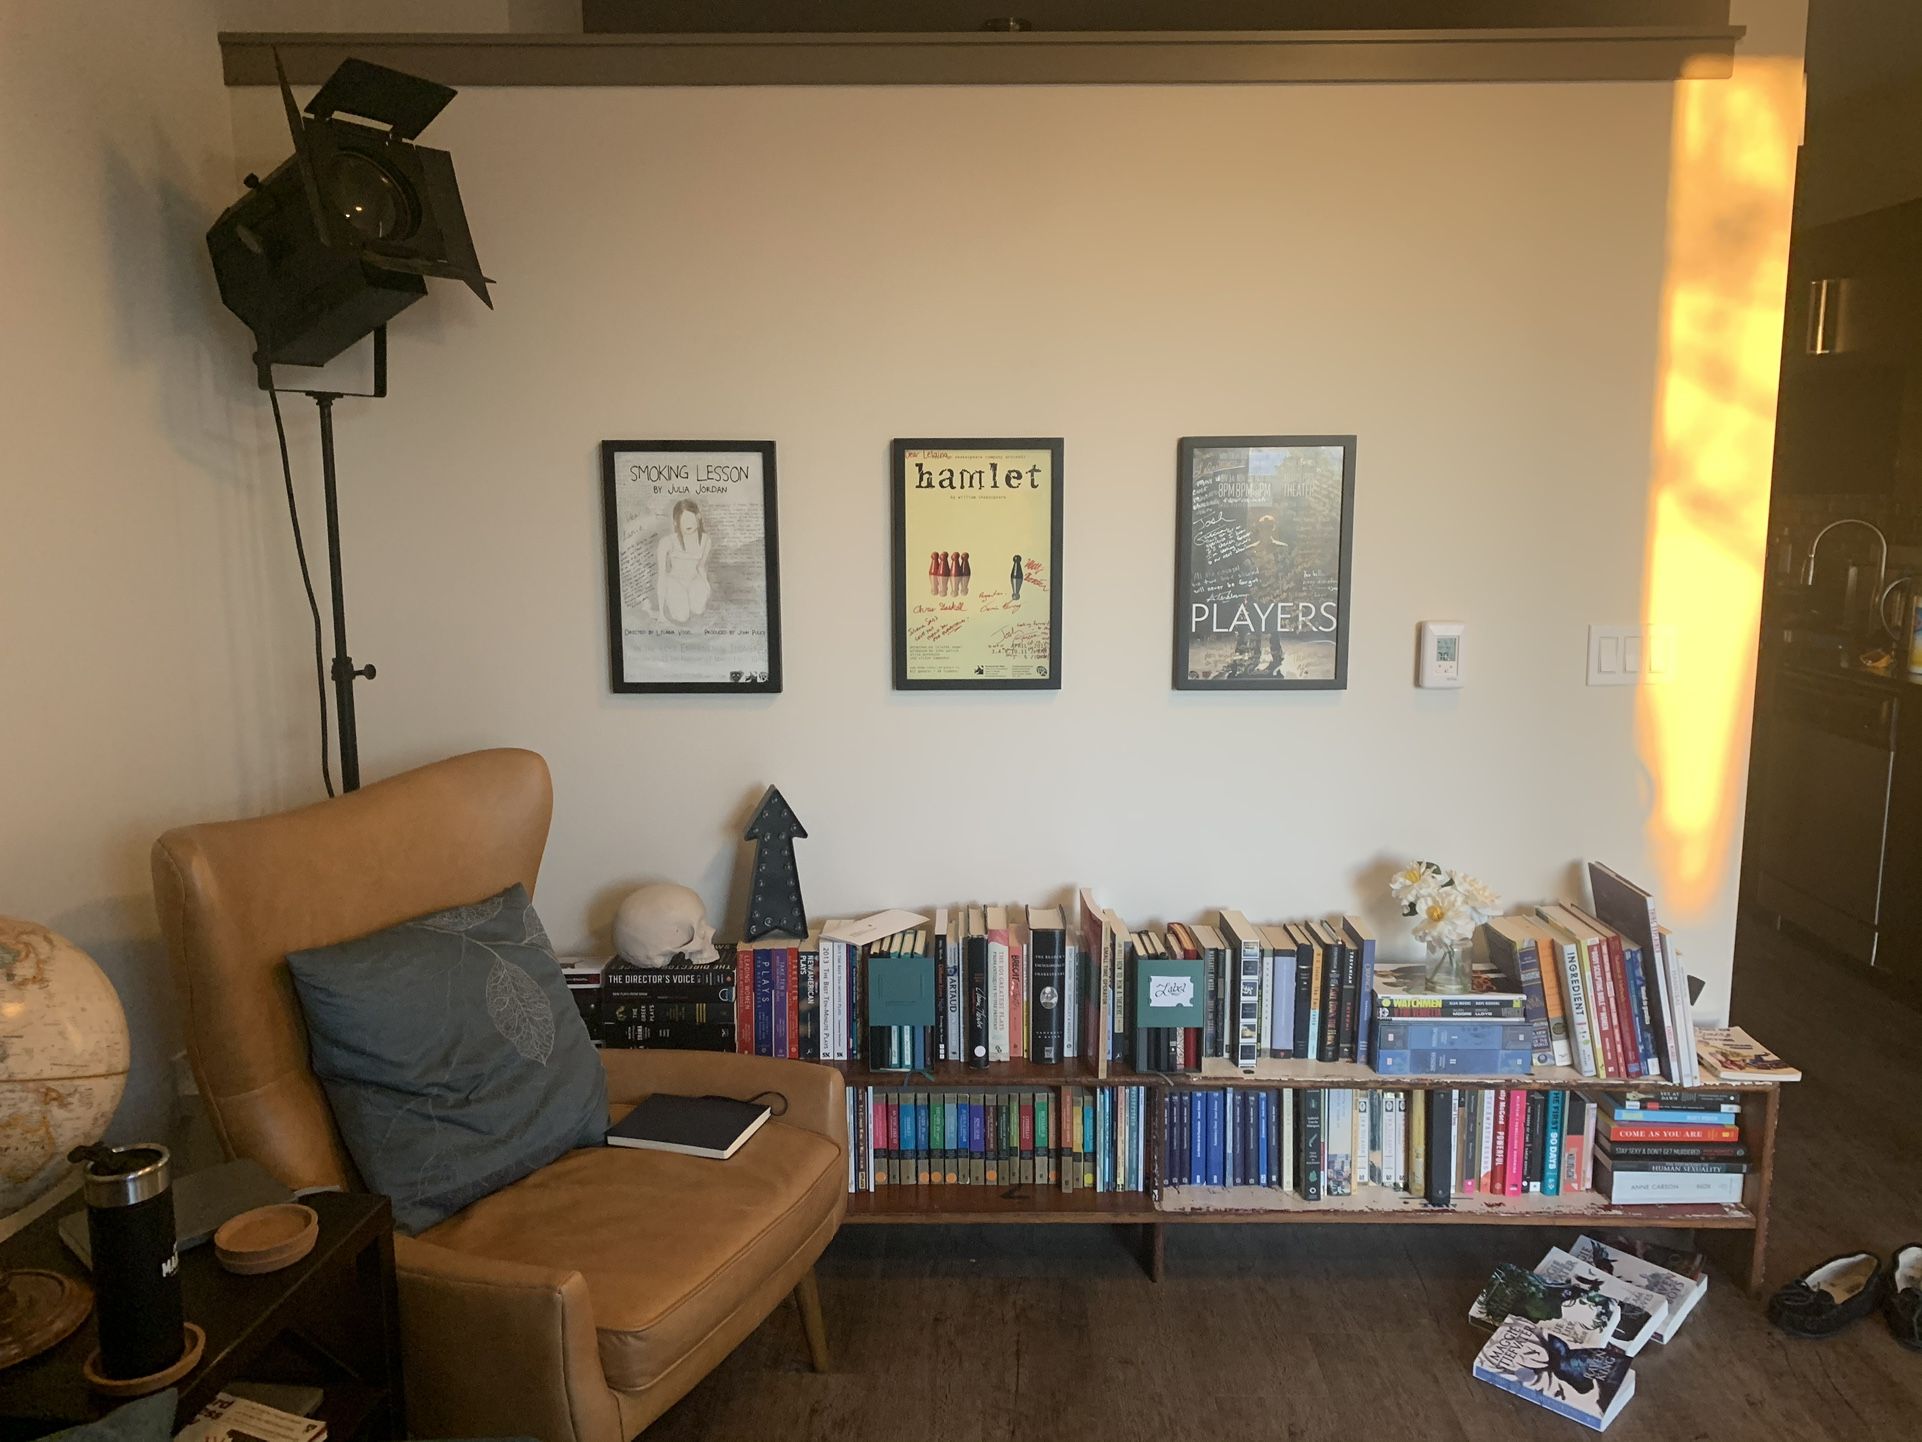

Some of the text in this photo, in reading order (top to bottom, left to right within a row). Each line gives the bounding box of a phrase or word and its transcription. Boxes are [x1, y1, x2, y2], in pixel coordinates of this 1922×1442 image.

[629, 465, 750, 483] SMOKING LESSON
[915, 462, 1042, 490] hamlet
[653, 484, 728, 495] BY JULIA JORDAN
[1191, 602, 1337, 632] PLAYERS
[608, 975, 695, 984] THE DIRECTOR'S VOICE
[762, 961, 770, 1002] PLAYS
[1567, 952, 1585, 1017] INGREDIENT
[949, 978, 957, 1013] ARTAUD
[1393, 999, 1443, 1008] WATCHMEN
[1495, 1131, 1505, 1166] POWERFUL
[1549, 1106, 1560, 1169] FIRST 90 DAYS
[1489, 1325, 1521, 1361] MAGGIE
[1596, 1356, 1616, 1381] KING
